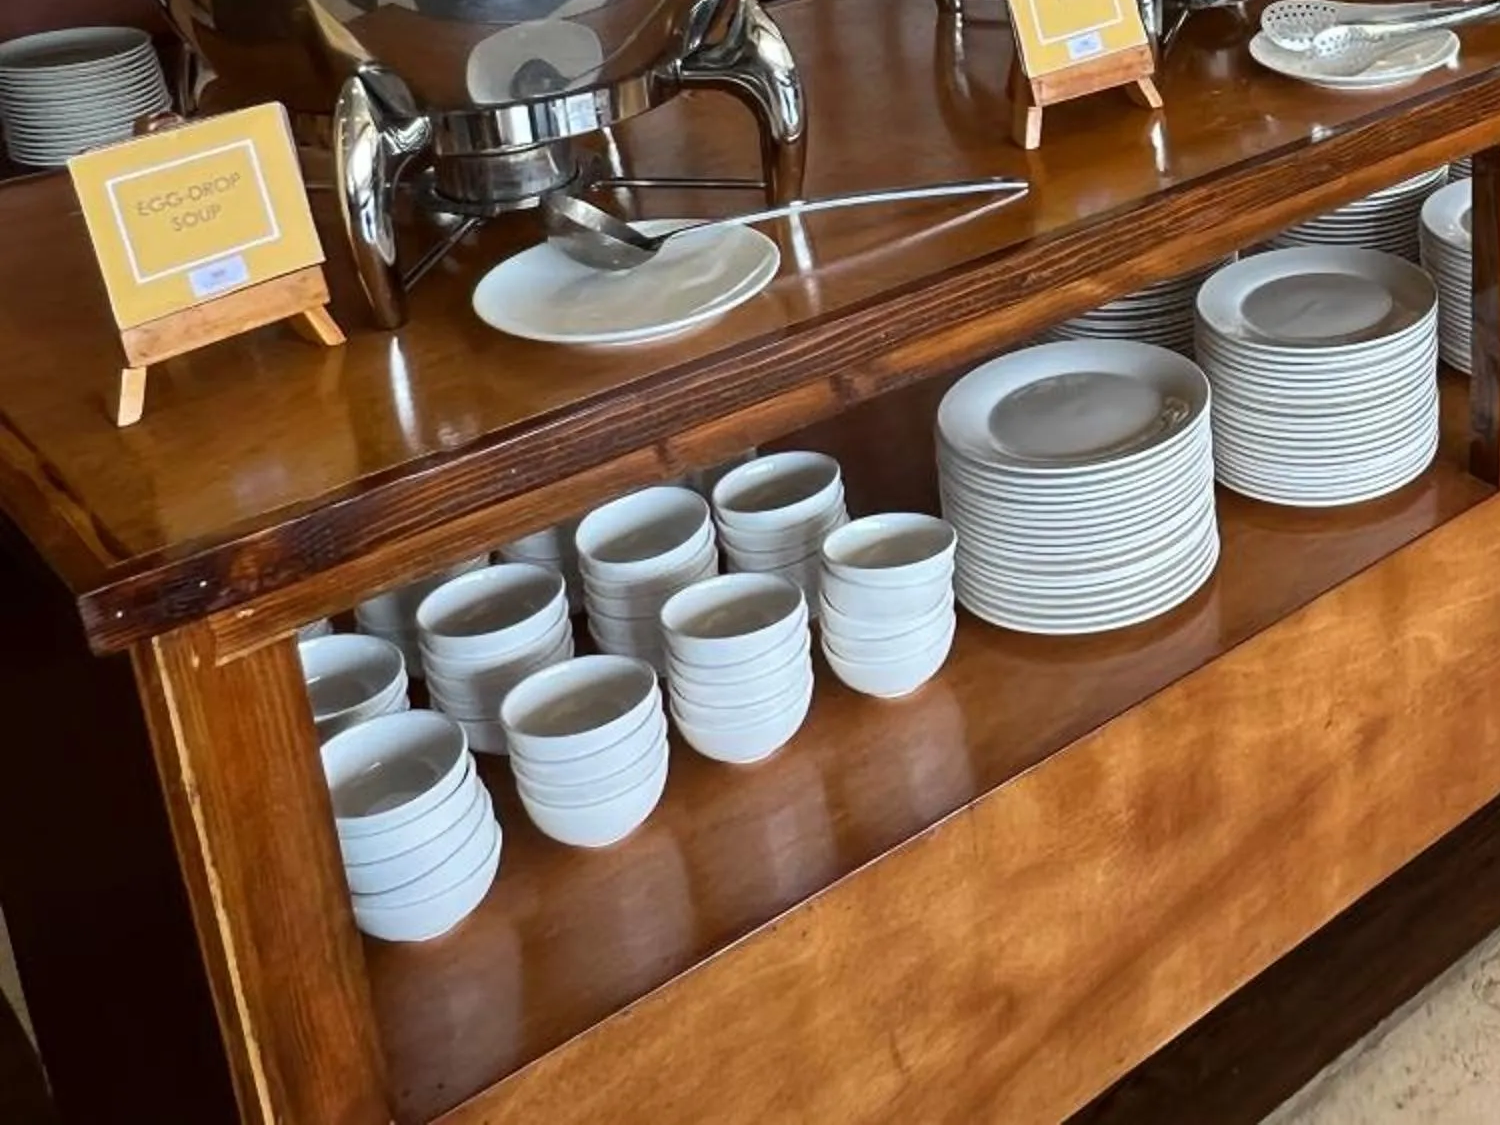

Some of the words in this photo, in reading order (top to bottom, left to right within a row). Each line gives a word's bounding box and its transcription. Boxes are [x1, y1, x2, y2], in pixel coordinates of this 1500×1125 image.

[137, 191, 183, 216] EGG
[188, 171, 241, 201] DROP
[171, 204, 221, 232] SOUP
